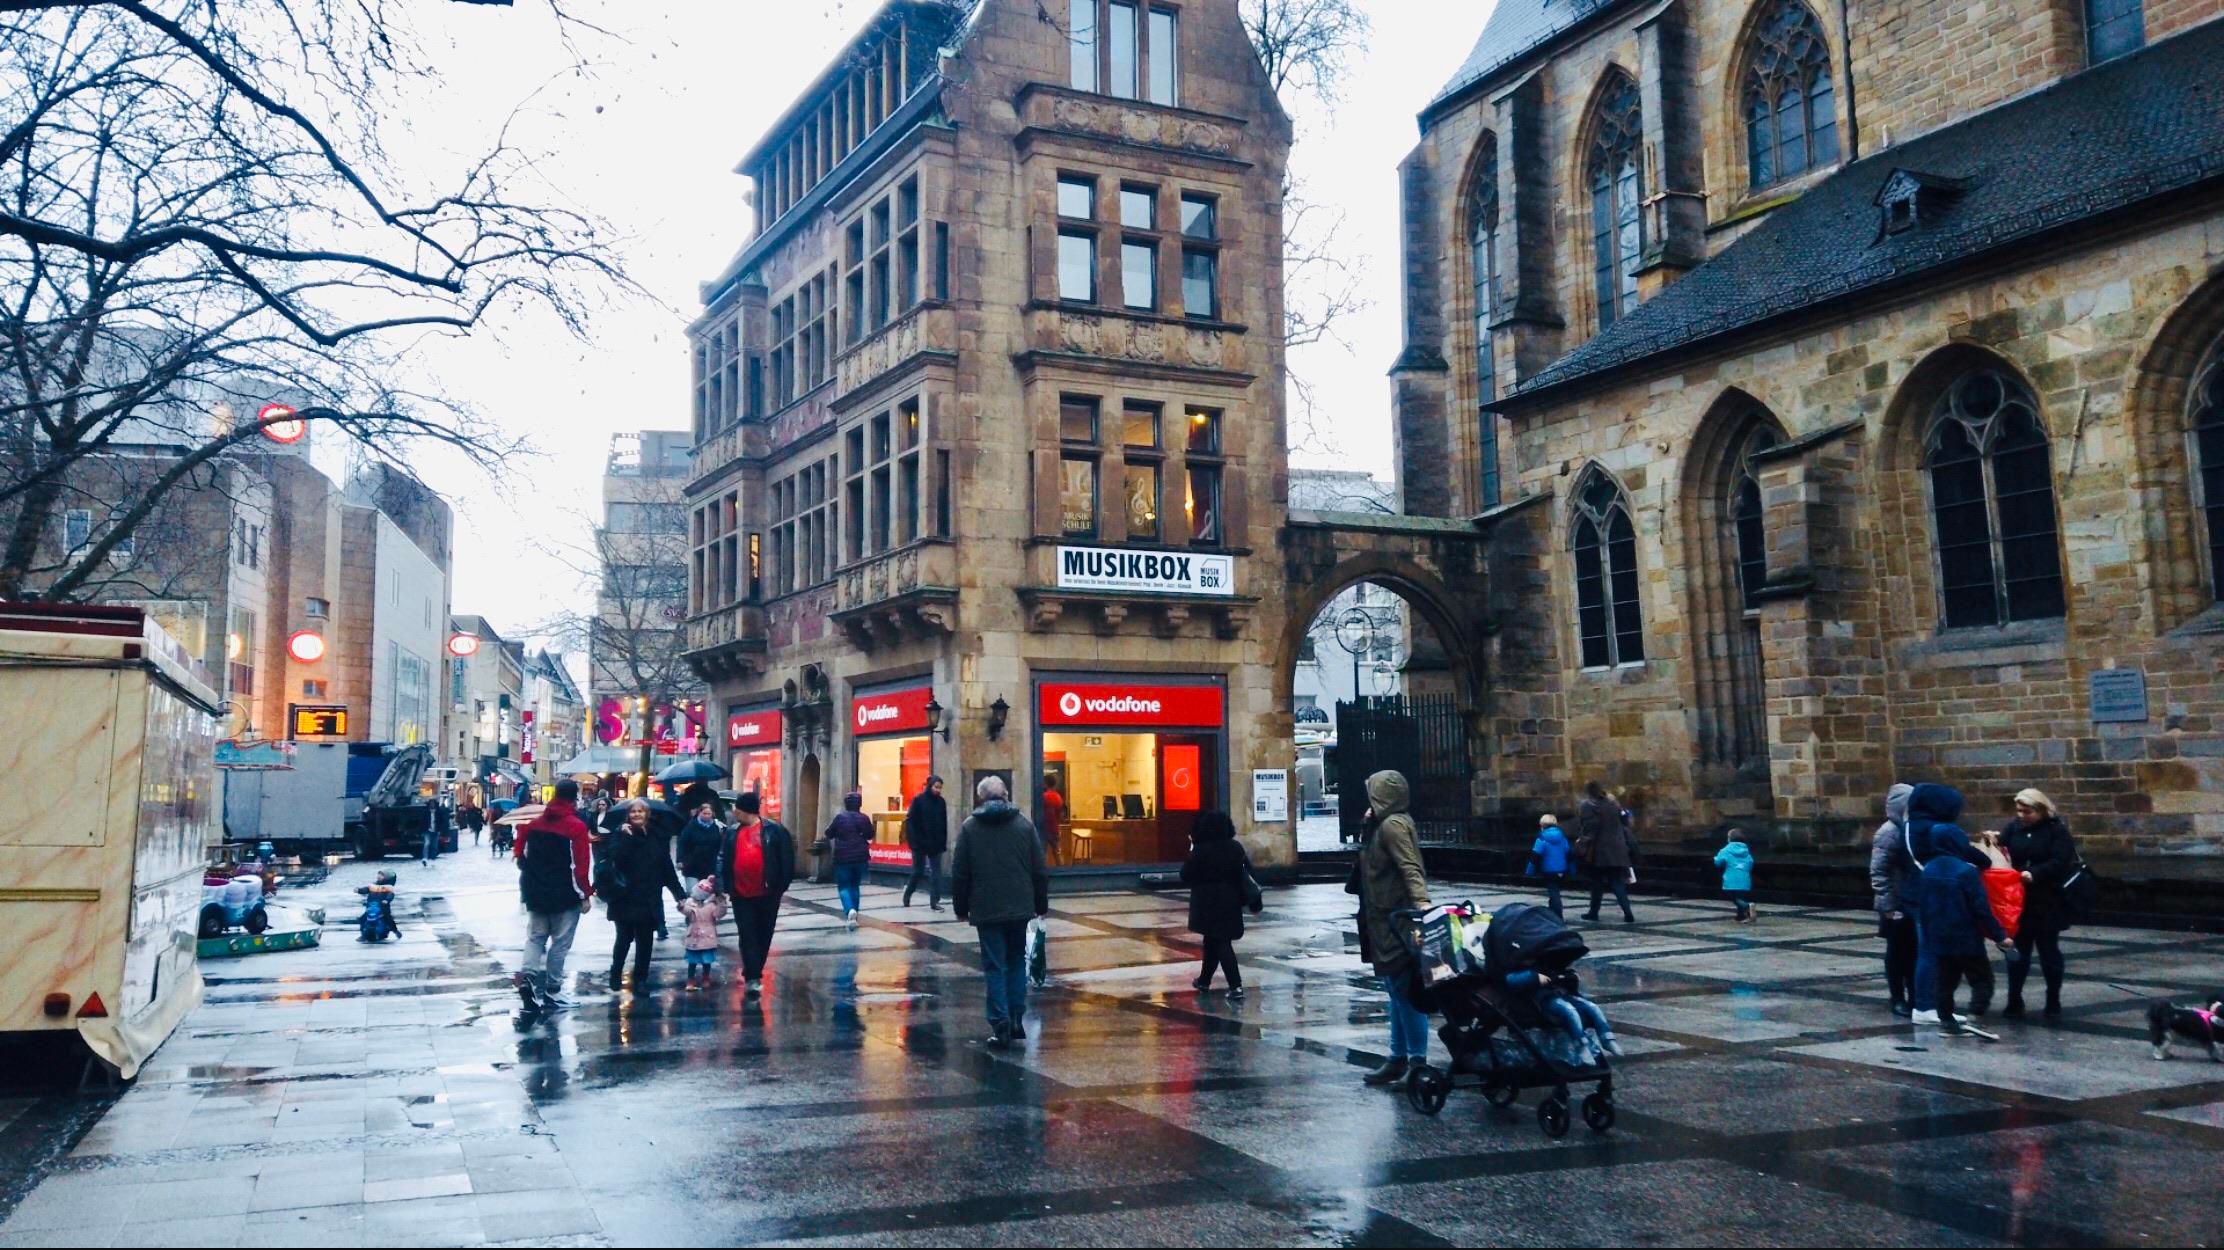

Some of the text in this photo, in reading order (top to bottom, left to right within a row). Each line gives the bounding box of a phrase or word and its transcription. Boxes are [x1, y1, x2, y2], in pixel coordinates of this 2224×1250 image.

[1064, 551, 1191, 580] MUSIKBOX
[1200, 567, 1220, 576] MUSIK
[1200, 575, 1220, 588] BOX
[866, 703, 899, 720] vodafone
[1085, 696, 1161, 713] vodafone
[738, 724, 760, 736] vodafone
